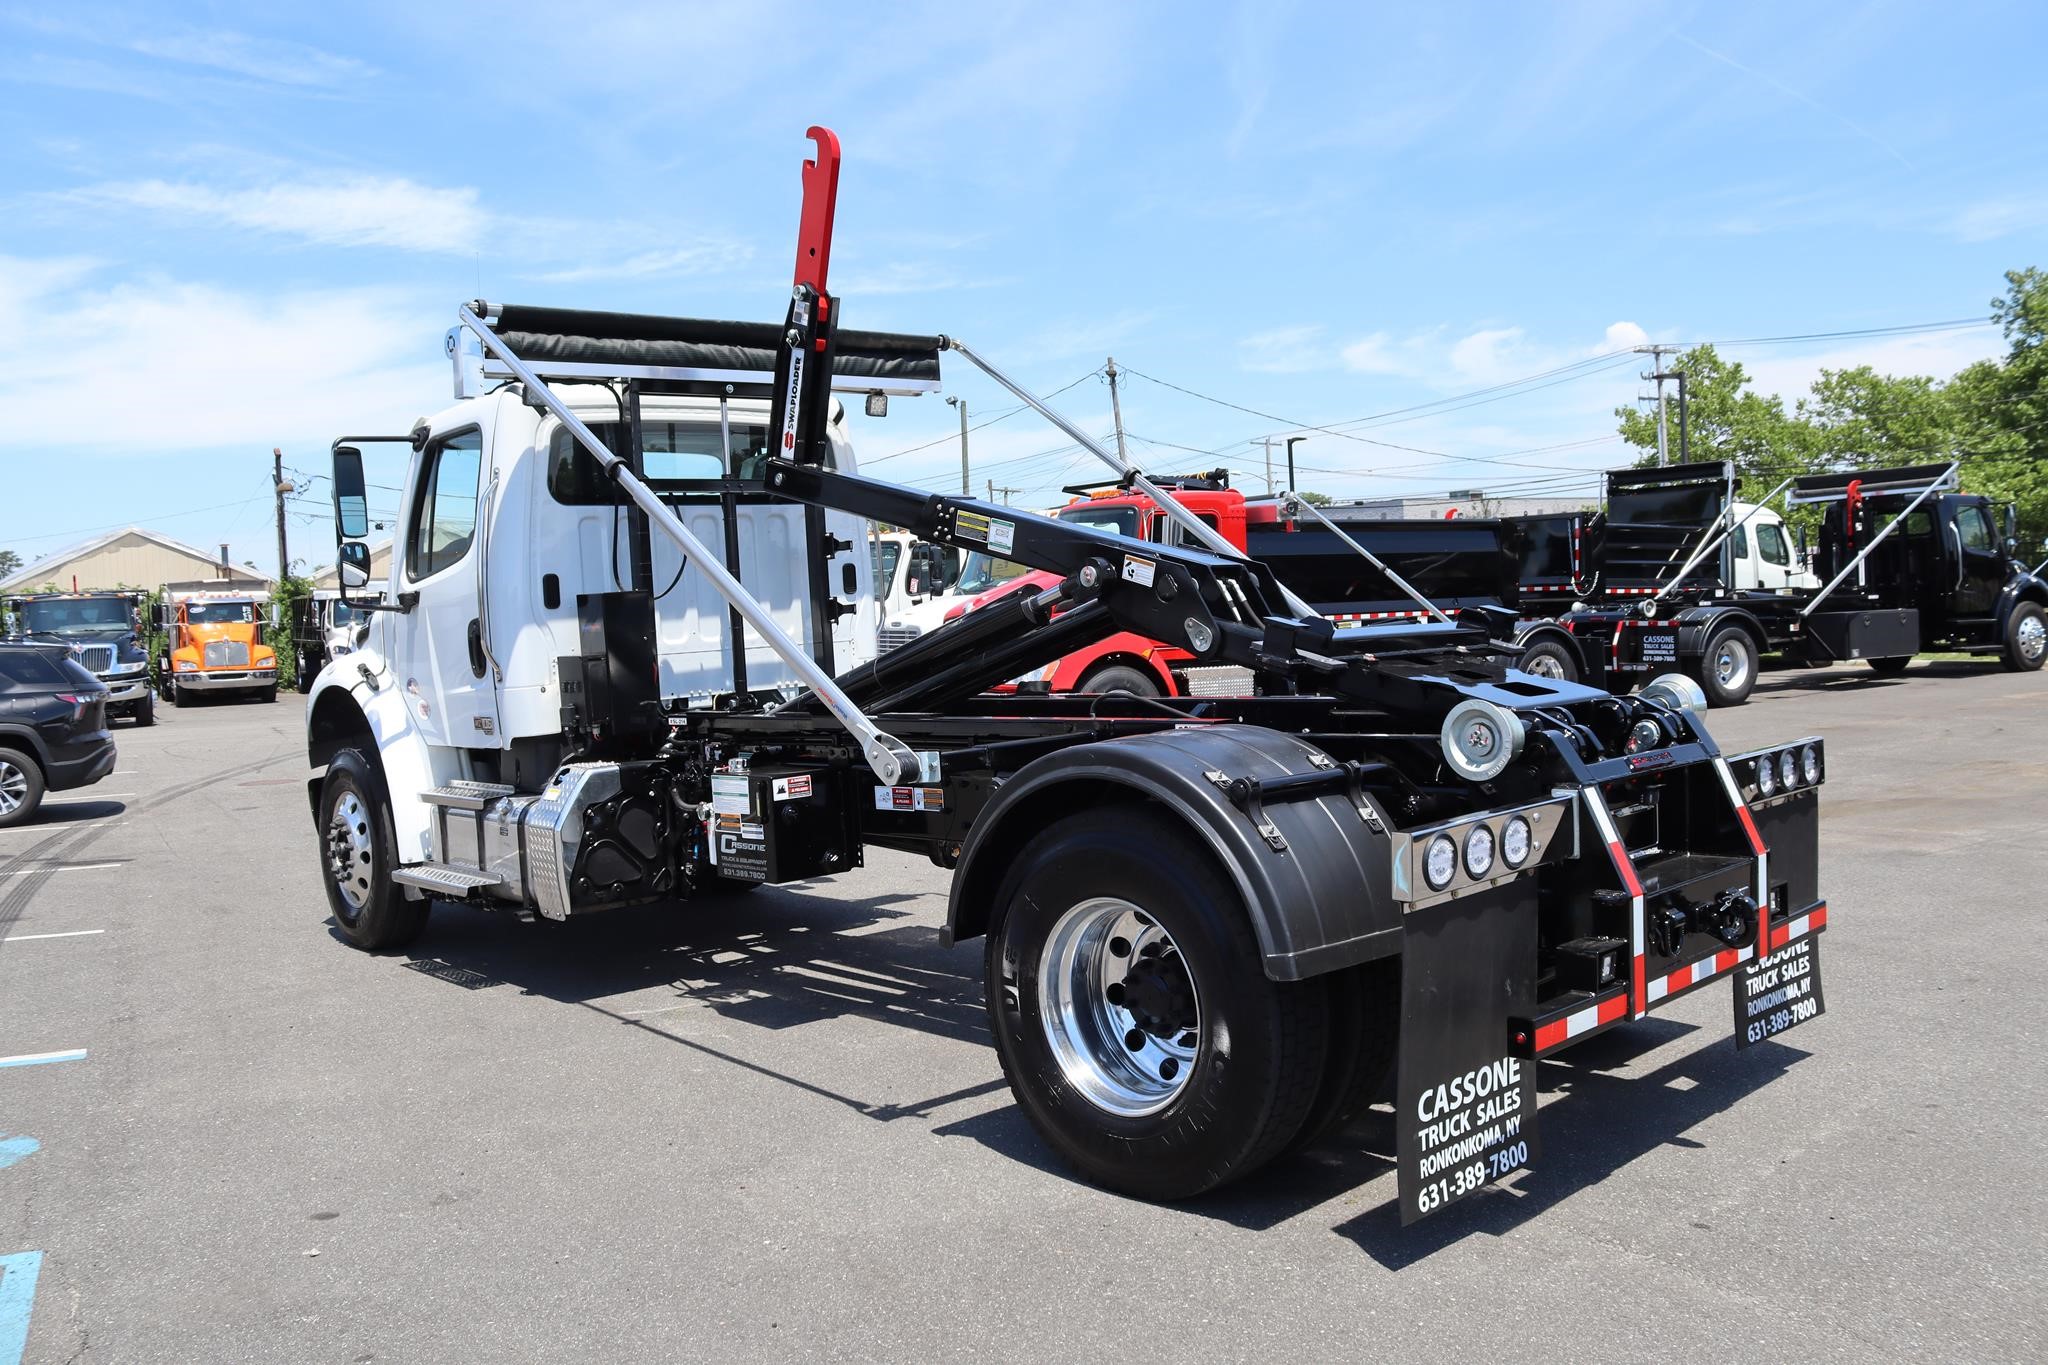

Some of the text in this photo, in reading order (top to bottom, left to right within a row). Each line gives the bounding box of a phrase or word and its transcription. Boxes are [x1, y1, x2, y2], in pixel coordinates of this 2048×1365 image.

[788, 357, 801, 430] SWAPLOADER
[1746, 968, 1779, 997] TRUCK
[1781, 956, 1811, 982] SALES
[1747, 976, 1811, 1018] RONKONKOMA, NY
[1747, 997, 1817, 1043] 631-389-7800
[1417, 1056, 1521, 1123] CASSONE
[1418, 1087, 1521, 1152] TRUCK SALES
[1418, 1140, 1528, 1213] 631-389-7800
[1420, 1114, 1521, 1179] RONKONKOMA, NY
